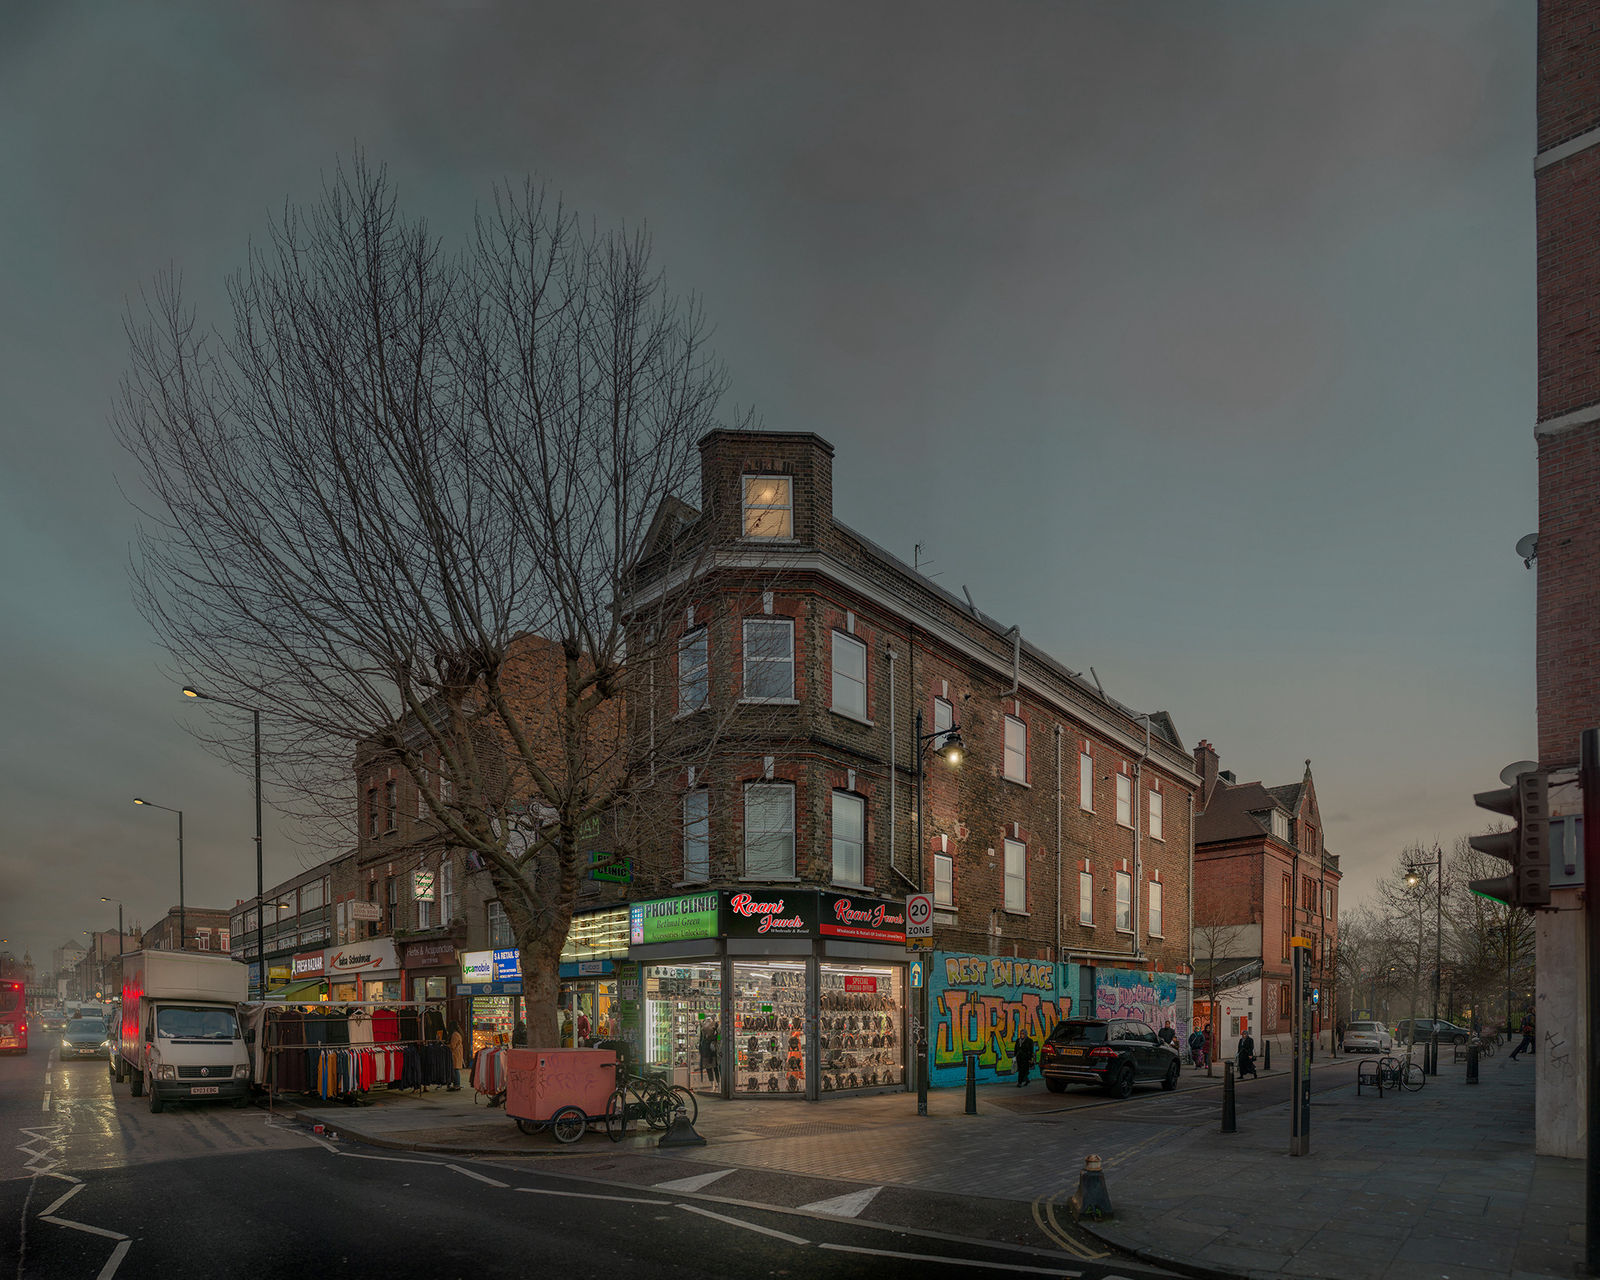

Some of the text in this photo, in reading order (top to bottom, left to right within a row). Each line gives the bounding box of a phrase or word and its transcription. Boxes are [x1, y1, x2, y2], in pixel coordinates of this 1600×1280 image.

[644, 896, 718, 918] PHONE CLINIC
[732, 893, 785, 917] Raani
[833, 899, 905, 928] Raani Jewels
[911, 904, 928, 916] 20
[681, 916, 700, 927] Green
[759, 914, 804, 934] Jewels
[908, 926, 930, 935] ZONE
[463, 960, 490, 974] Lycamobile
[945, 957, 1055, 991] REST IN PEACE
[935, 989, 1074, 1076] JORDAN
